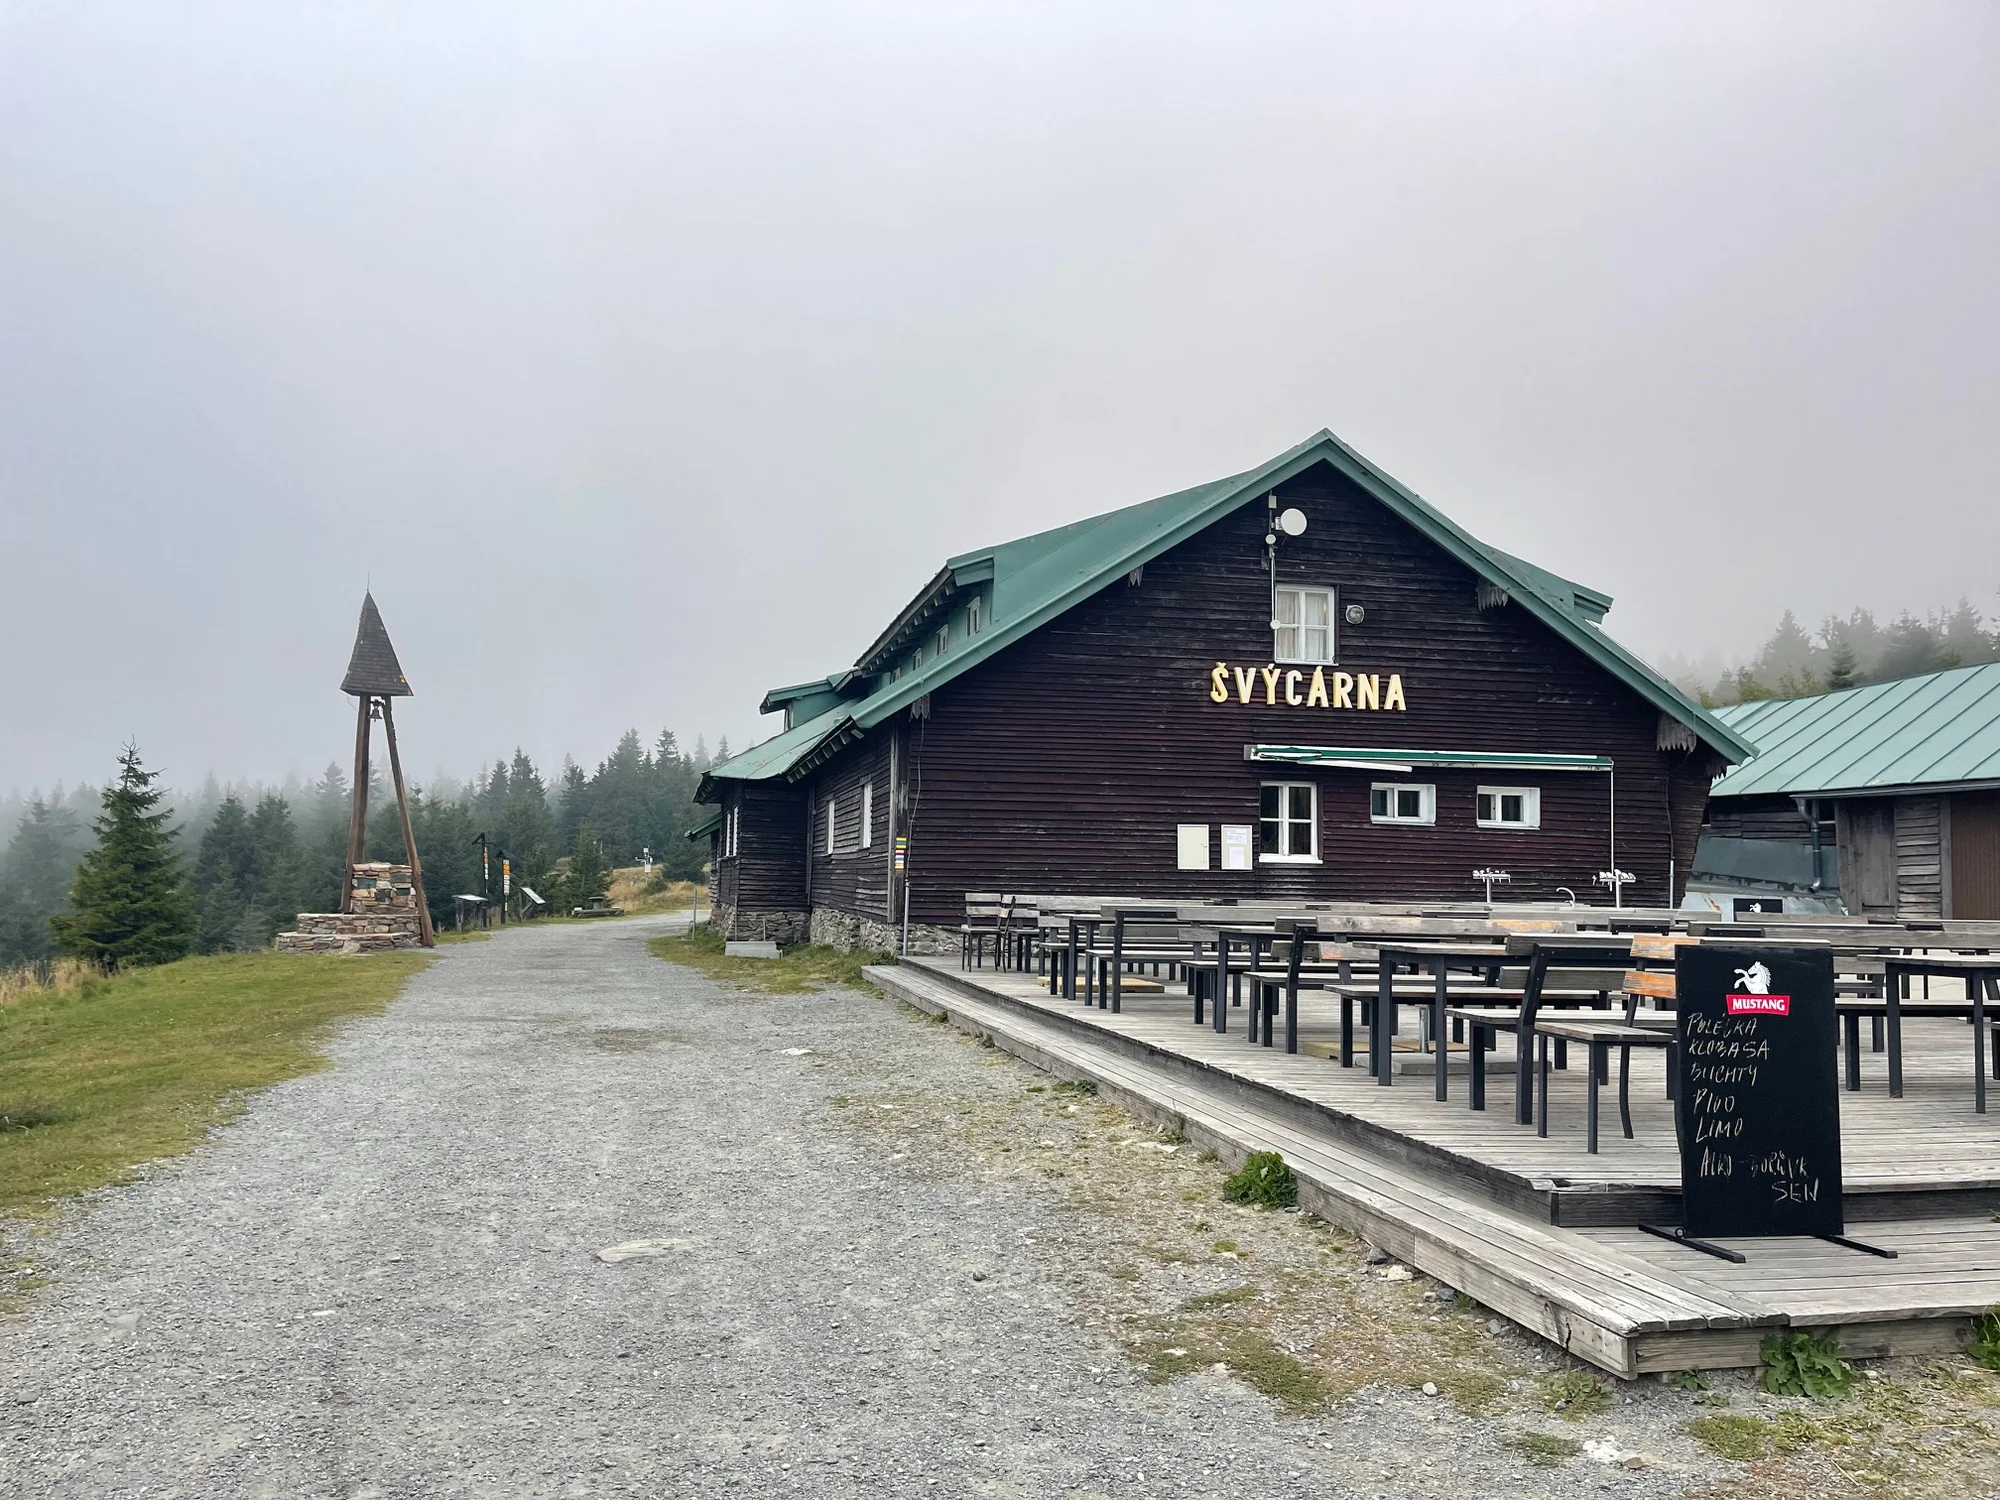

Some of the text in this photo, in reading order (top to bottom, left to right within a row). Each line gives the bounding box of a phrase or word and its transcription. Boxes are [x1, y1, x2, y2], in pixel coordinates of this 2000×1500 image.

[1209, 661, 1407, 711] ŠVÝCÁRNA
[1732, 998, 1786, 1011] MUSTANG
[1696, 1116, 1743, 1143] LIMO
[1772, 1178, 1819, 1202] SEN
